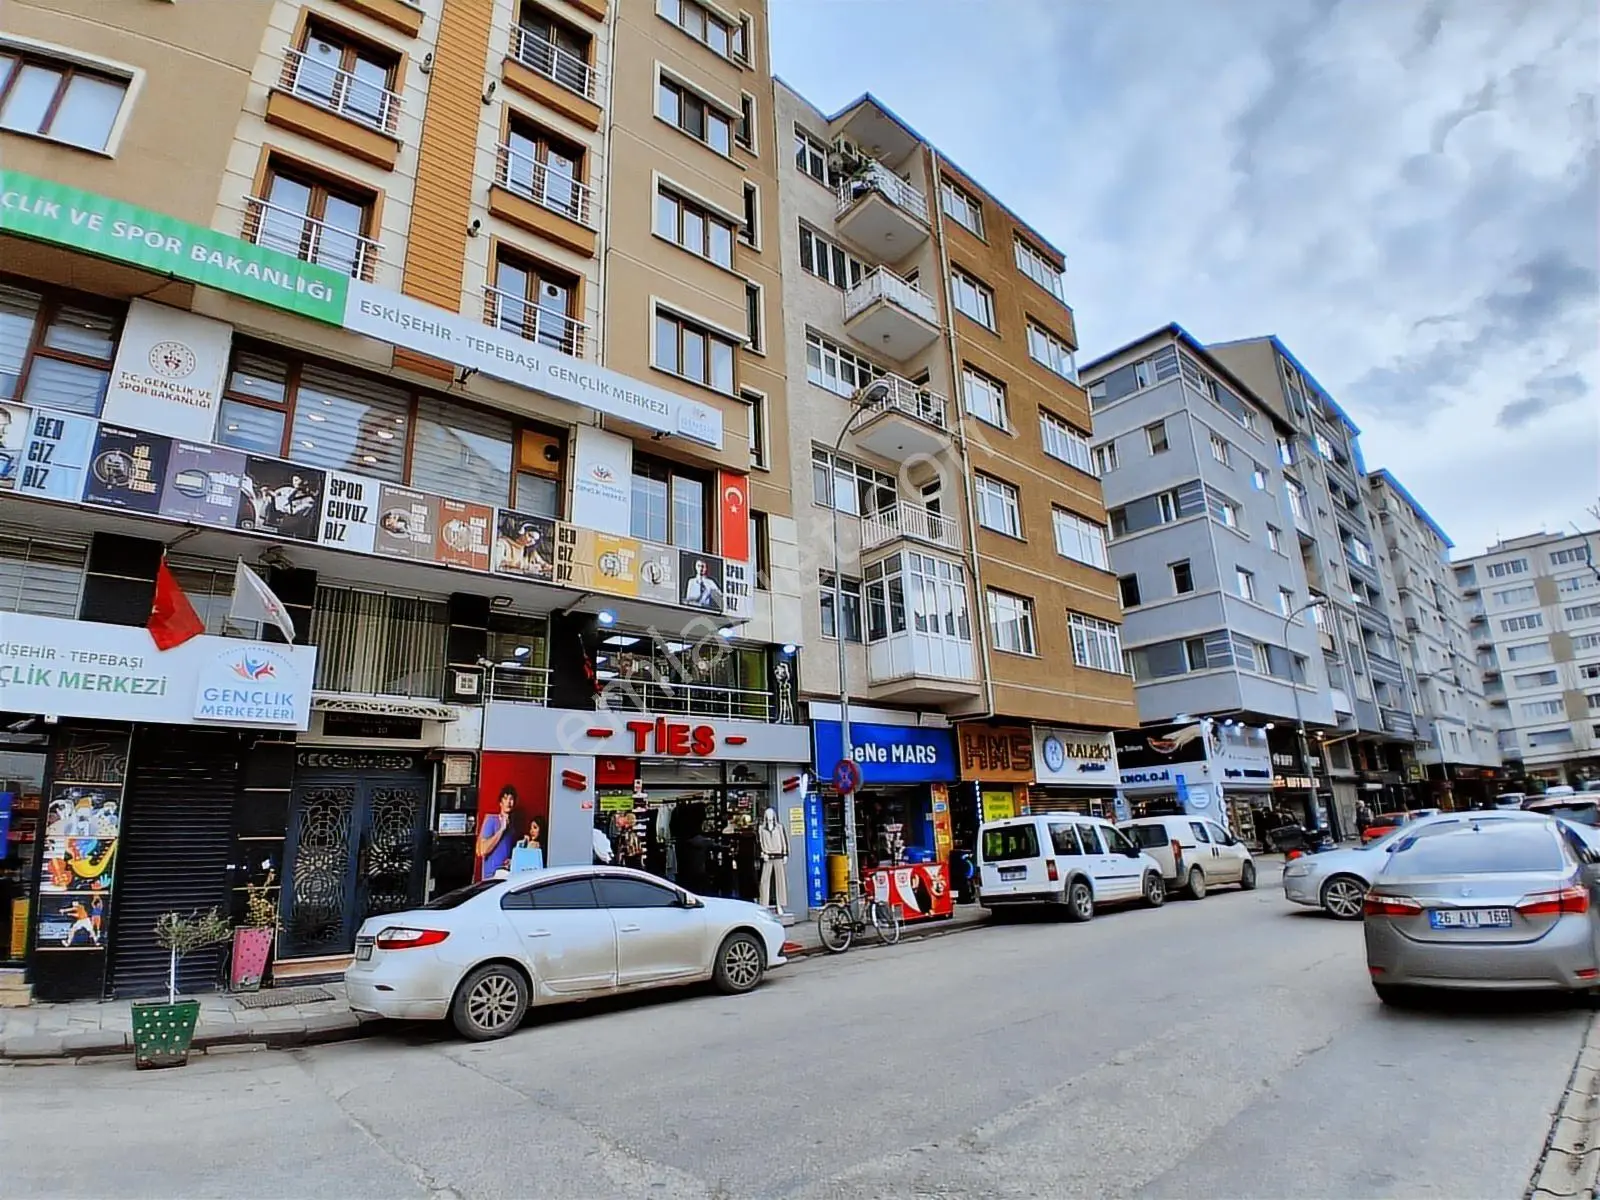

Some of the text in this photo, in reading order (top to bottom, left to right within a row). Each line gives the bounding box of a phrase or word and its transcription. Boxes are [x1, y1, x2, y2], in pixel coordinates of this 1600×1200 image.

[70, 207, 104, 232] VE
[111, 220, 183, 255] SPOR
[190, 244, 333, 302] BAKANLIĞI
[360, 299, 452, 341] ESKİŞEHİR
[465, 335, 541, 372] TEPEBAŞI
[548, 365, 610, 395] GENÇLİK
[612, 387, 669, 417] MERKEZİ
[118, 382, 148, 395] SPOR
[198, 390, 212, 400] VE
[330, 478, 363, 501] SPOR
[70, 650, 144, 671] TEPEBAŞI
[57, 670, 168, 697] MERKEZİ
[627, 717, 717, 756] TİES
[891, 744, 937, 764] MARS
